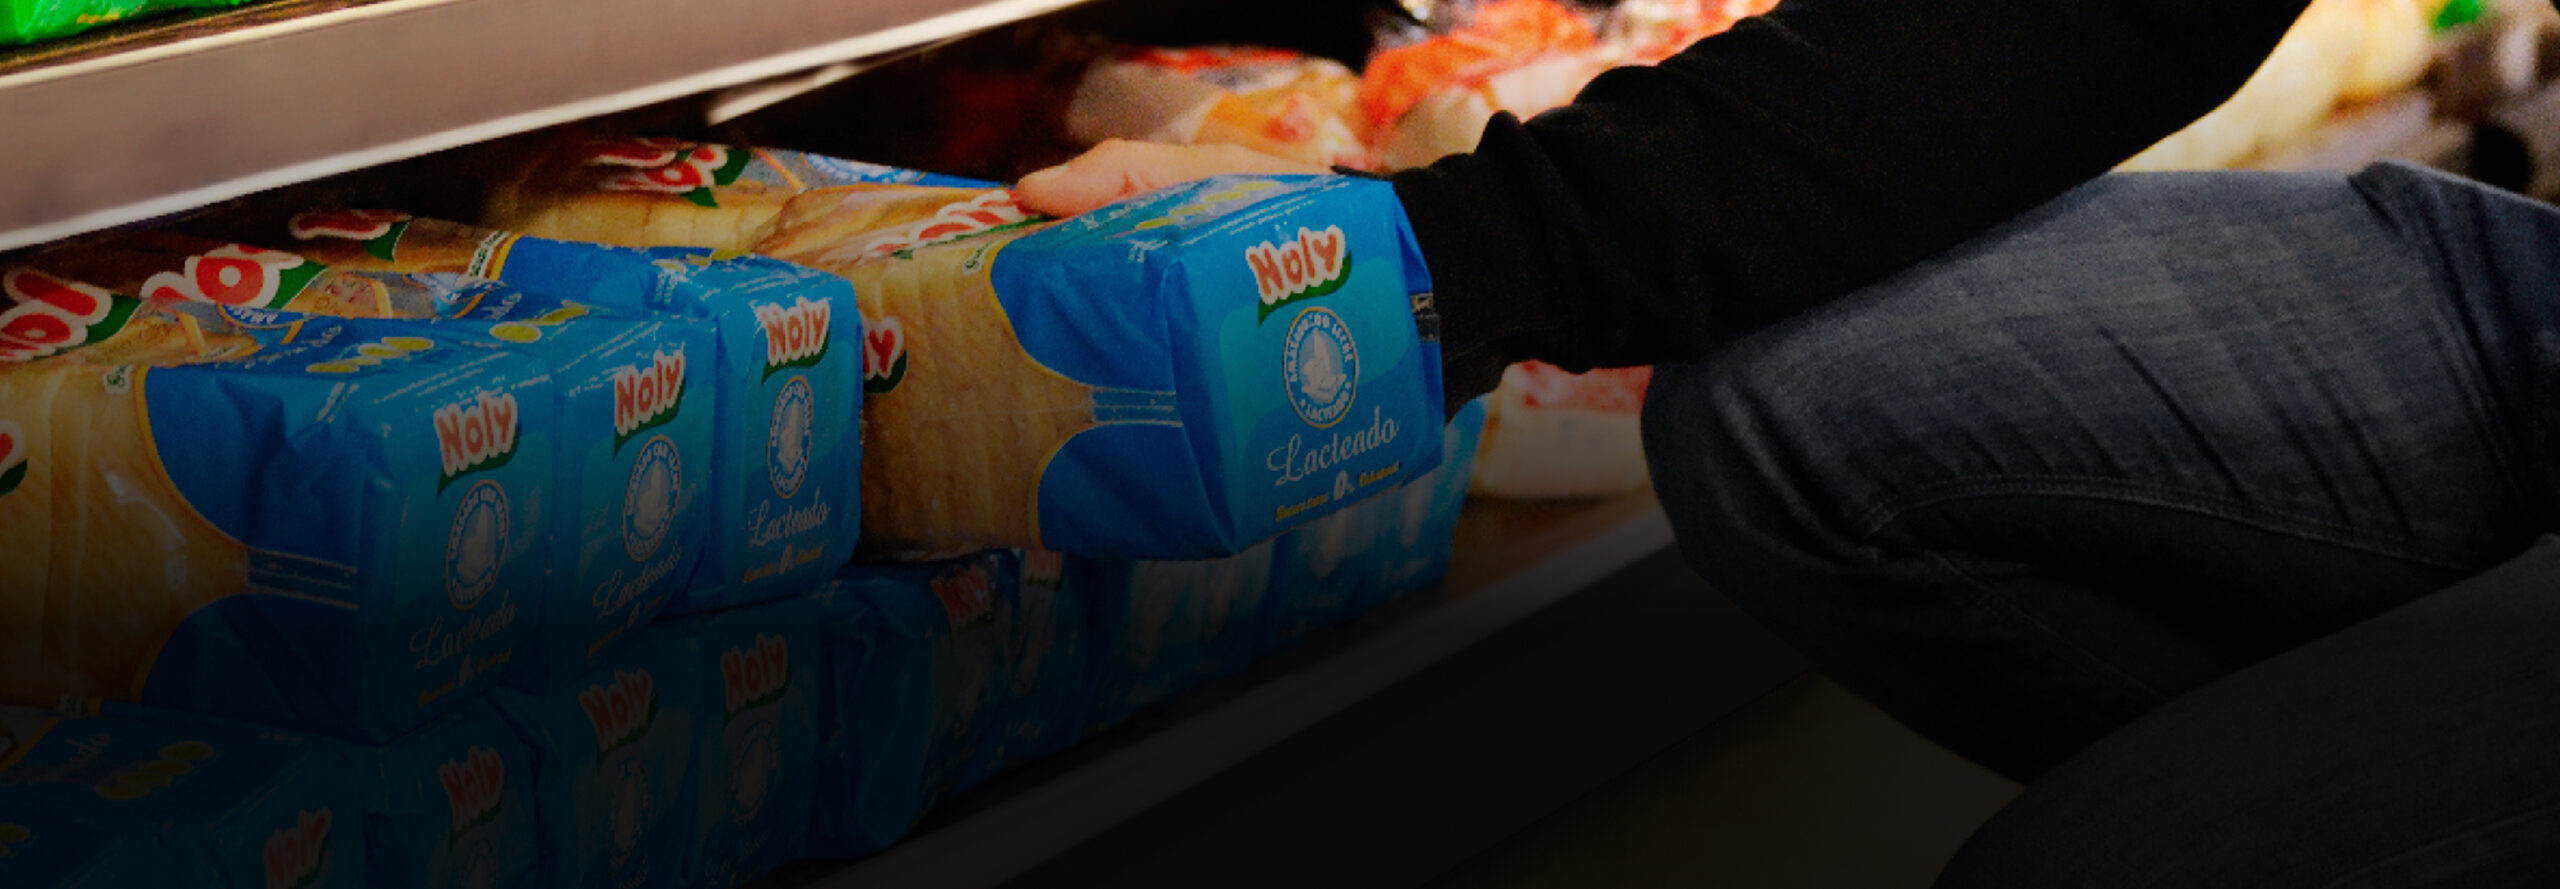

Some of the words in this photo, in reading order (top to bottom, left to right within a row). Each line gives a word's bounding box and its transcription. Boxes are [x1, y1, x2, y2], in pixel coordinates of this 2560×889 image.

[1245, 224, 1346, 305] Noly
[757, 296, 831, 367] Noly
[433, 391, 518, 478] Noly
[613, 350, 686, 437] Noly
[1266, 404, 1400, 487] Lacteado
[578, 666, 655, 752] Noly
[720, 632, 789, 715] Noly
